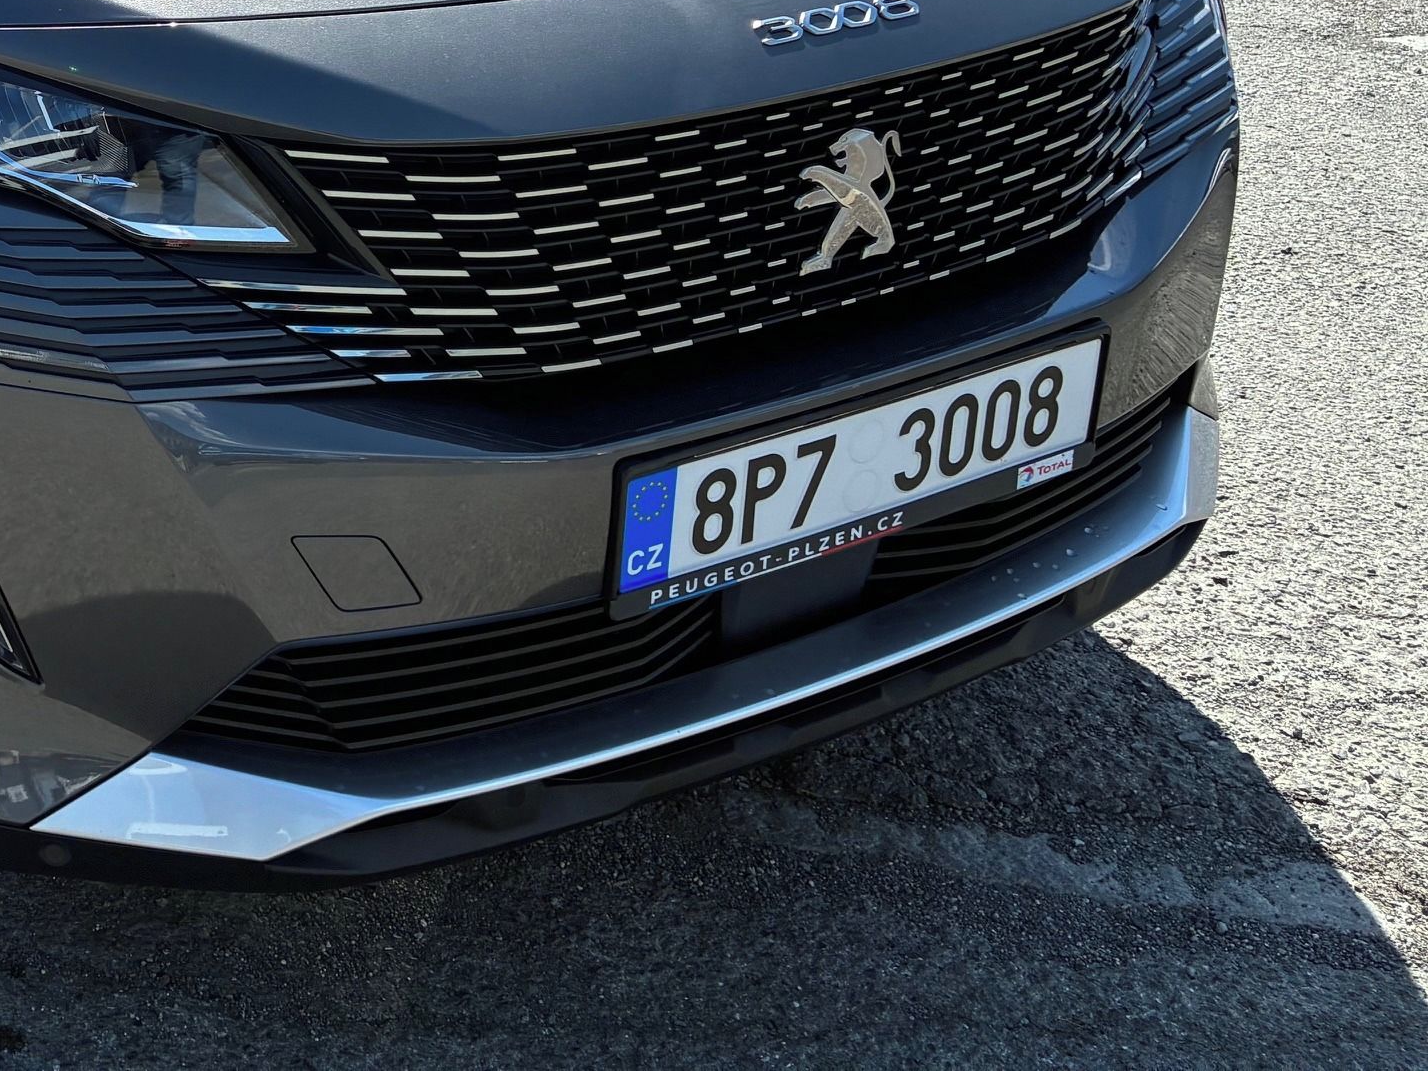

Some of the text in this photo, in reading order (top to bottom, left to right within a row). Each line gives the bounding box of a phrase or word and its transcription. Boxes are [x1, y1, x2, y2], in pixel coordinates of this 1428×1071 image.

[692, 366, 1063, 555] 8P7 3008
[1037, 459, 1072, 475] TOTAL
[627, 543, 663, 576] CZ
[650, 511, 905, 605] PEUGEOT-PLZEN.CZ
